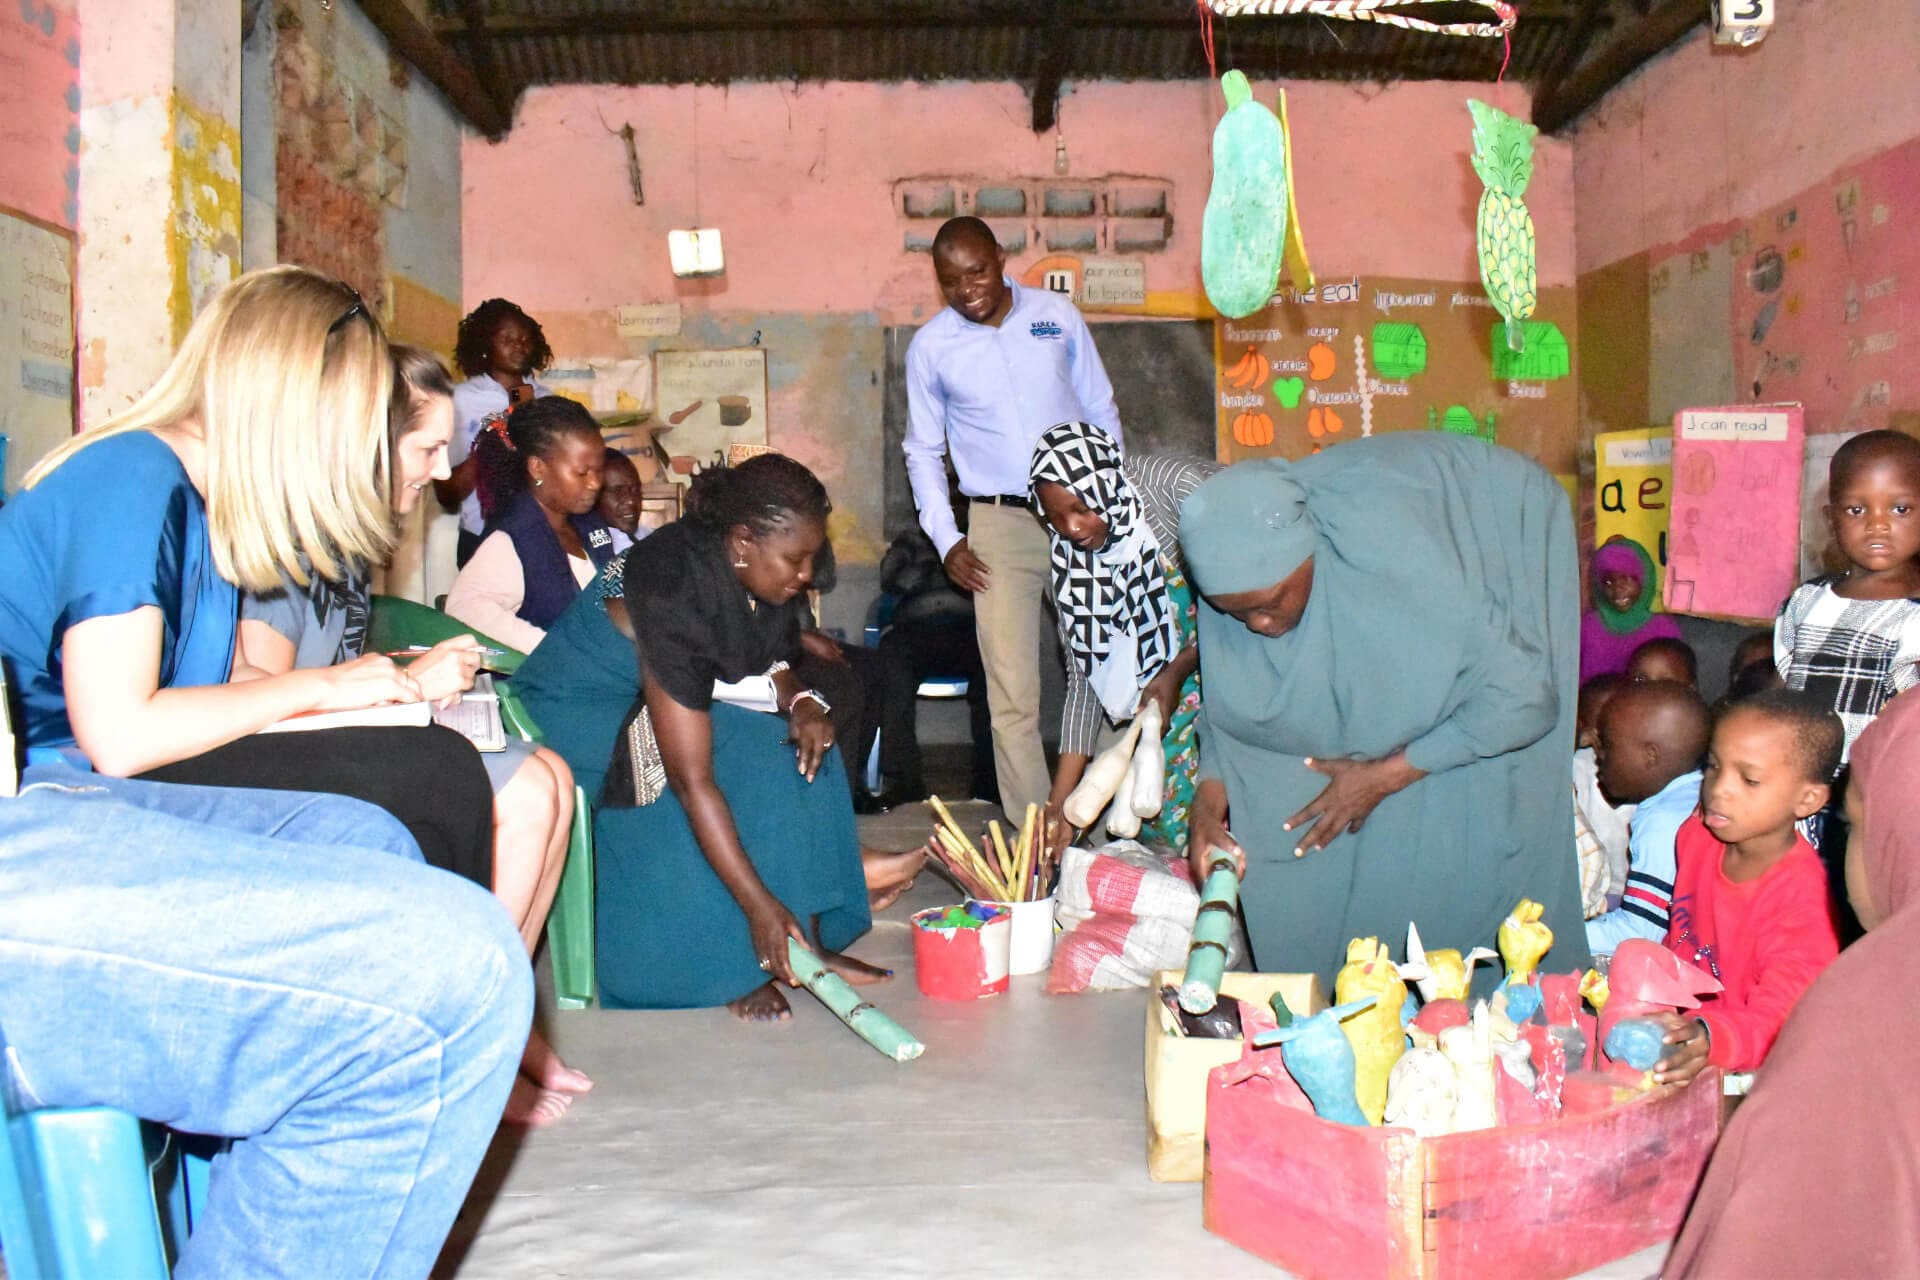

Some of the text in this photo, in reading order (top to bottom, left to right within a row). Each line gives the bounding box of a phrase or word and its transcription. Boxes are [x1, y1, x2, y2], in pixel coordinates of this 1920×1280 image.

[1321, 275, 1360, 303] eat
[1701, 420, 1728, 431] can
[1734, 415, 1768, 432] read
[1601, 477, 1666, 514] a e
